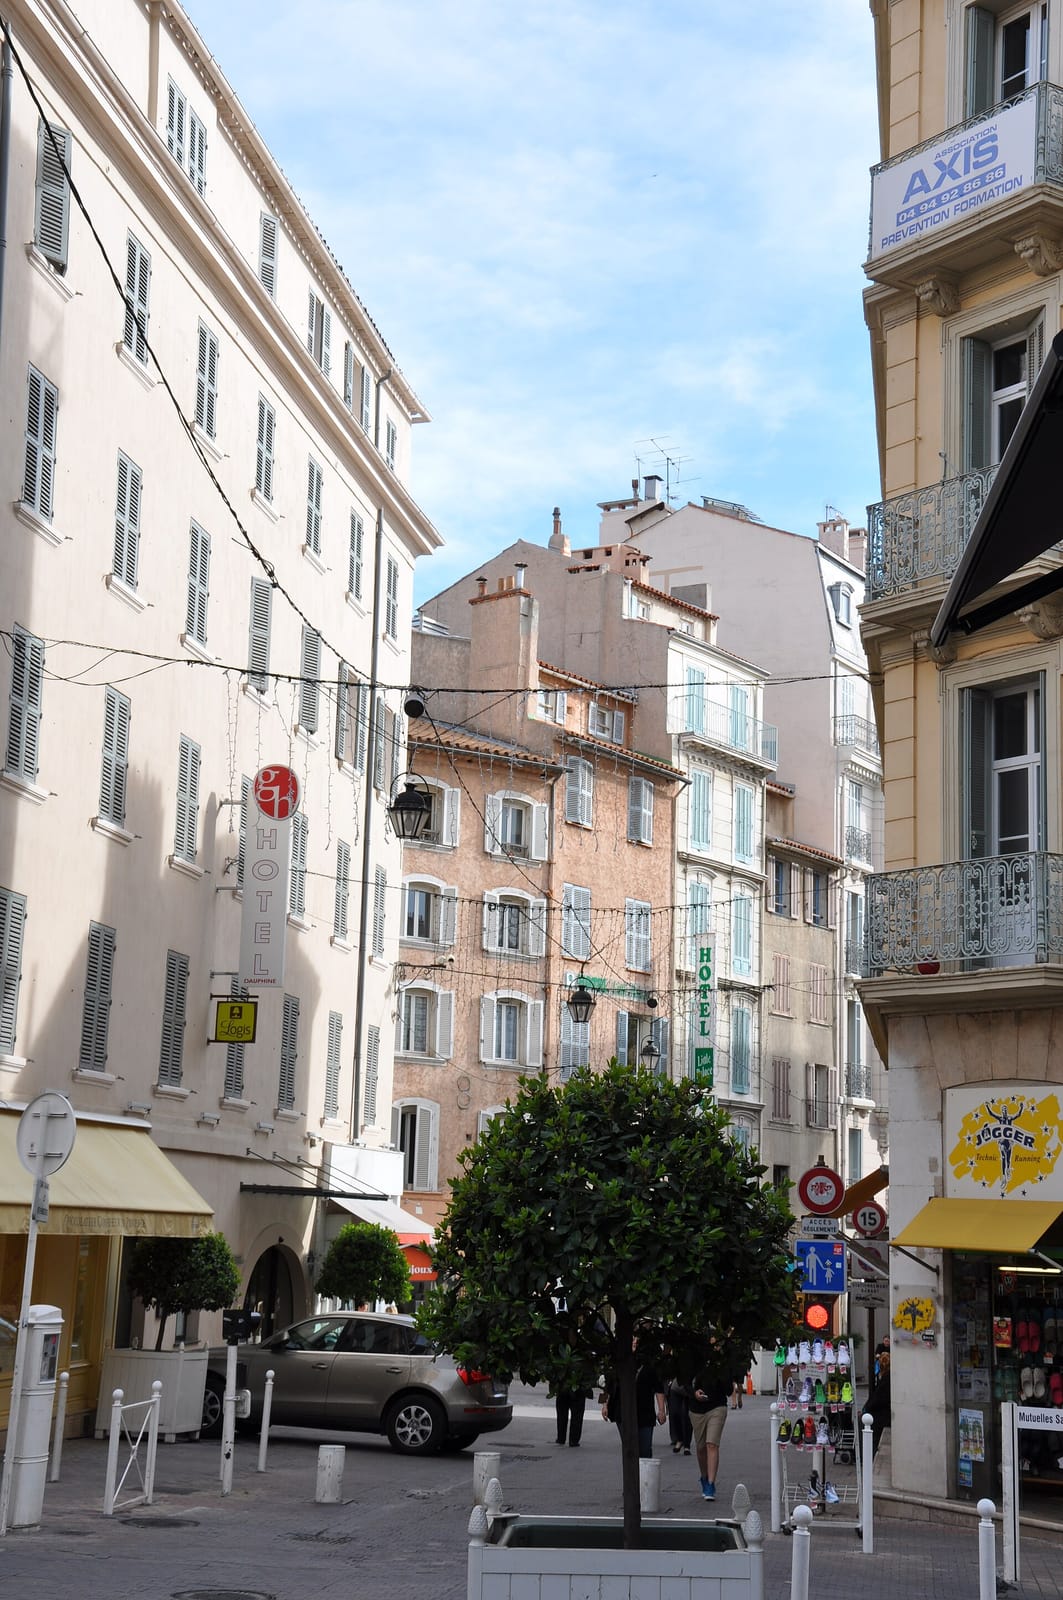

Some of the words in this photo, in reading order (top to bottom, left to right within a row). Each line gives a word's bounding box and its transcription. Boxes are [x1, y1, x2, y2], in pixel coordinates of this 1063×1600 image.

[902, 134, 999, 205] AXIS
[934, 124, 998, 160] ASSOCIATION
[881, 209, 950, 249] PREVENTION
[953, 175, 1023, 216] FORMATION
[899, 208, 915, 223] 04
[919, 200, 937, 214] 94
[941, 189, 958, 203] 92
[963, 179, 981, 194] 86
[985, 169, 1004, 183] 86
[251, 828, 280, 977] HOTEL
[698, 947, 712, 1037] HOTEL
[860, 1212, 877, 1227] 15
[1019, 1412, 1053, 1424] Mutuelles
